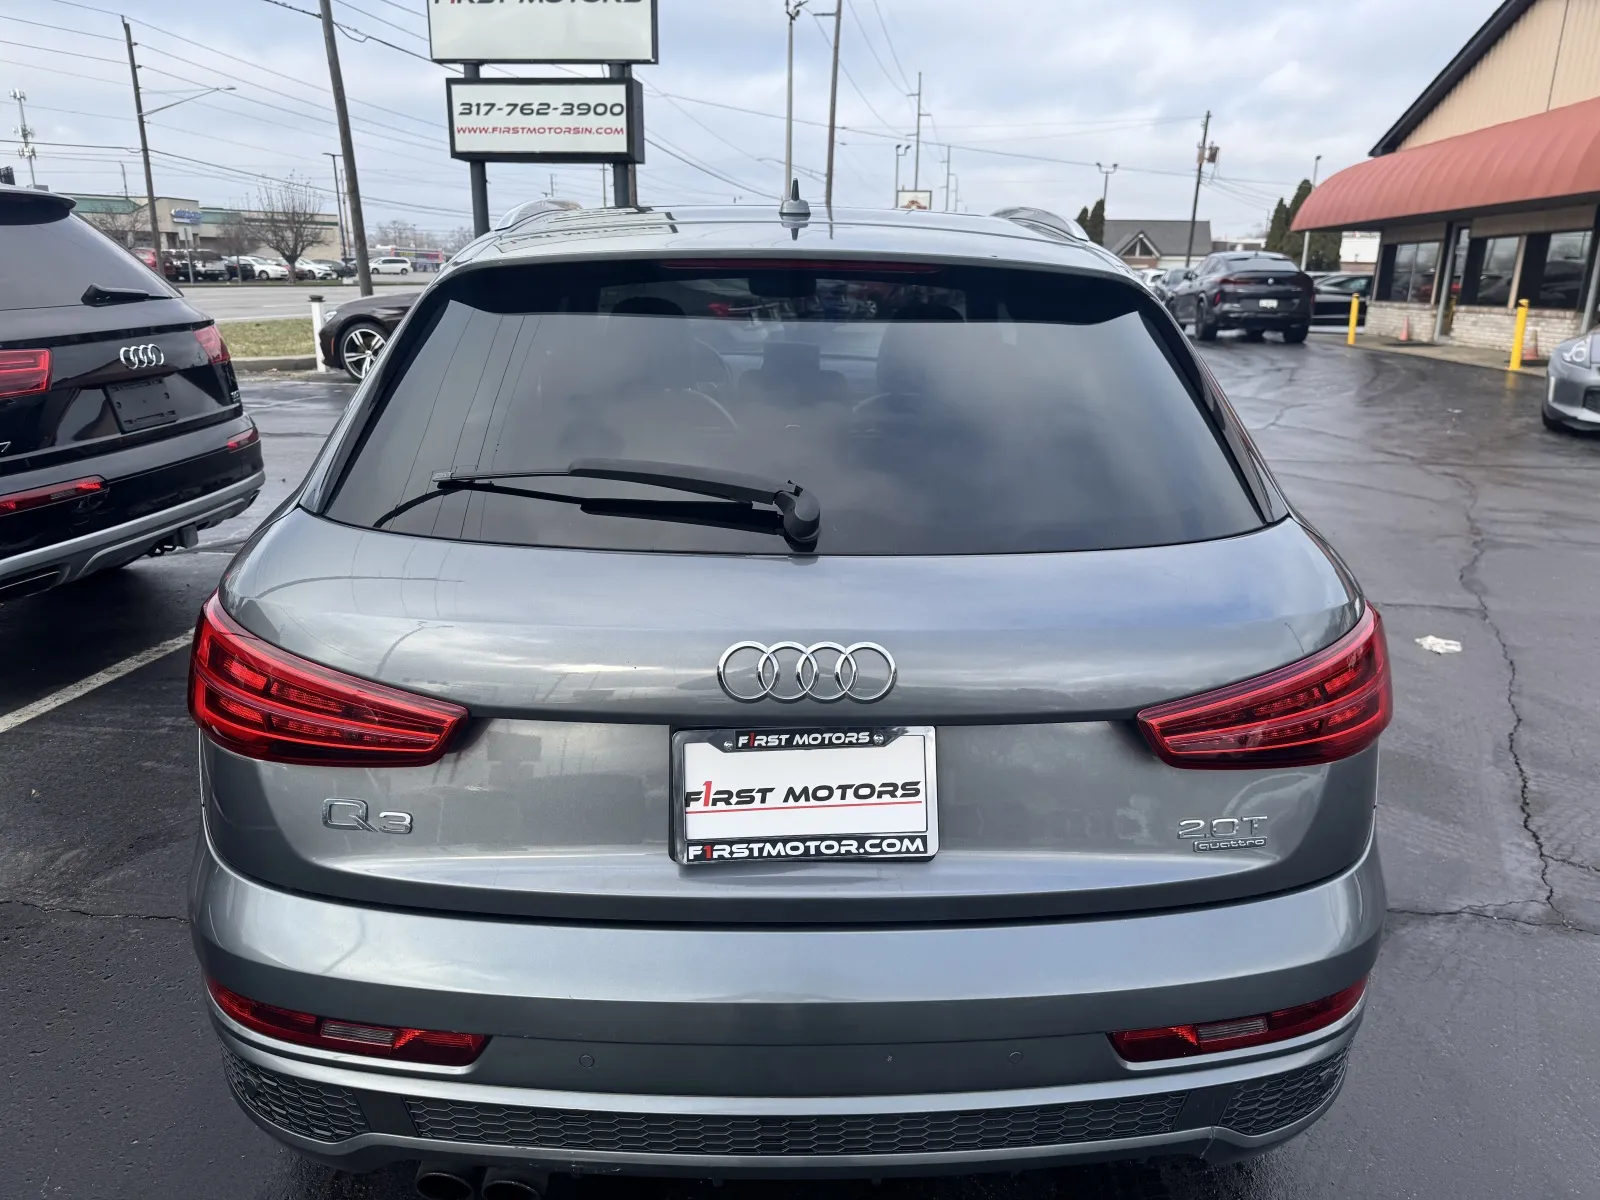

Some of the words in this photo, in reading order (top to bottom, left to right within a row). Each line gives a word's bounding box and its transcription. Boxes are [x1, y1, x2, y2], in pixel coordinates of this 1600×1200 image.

[458, 102, 625, 116] 317-762-3900
[456, 126, 624, 135] WWW.FIRSTMOTORSIN.COM
[792, 731, 870, 746] MOTORS
[783, 781, 921, 803] MOTORS
[322, 798, 413, 834] Q3
[1198, 839, 1265, 850] quattro
